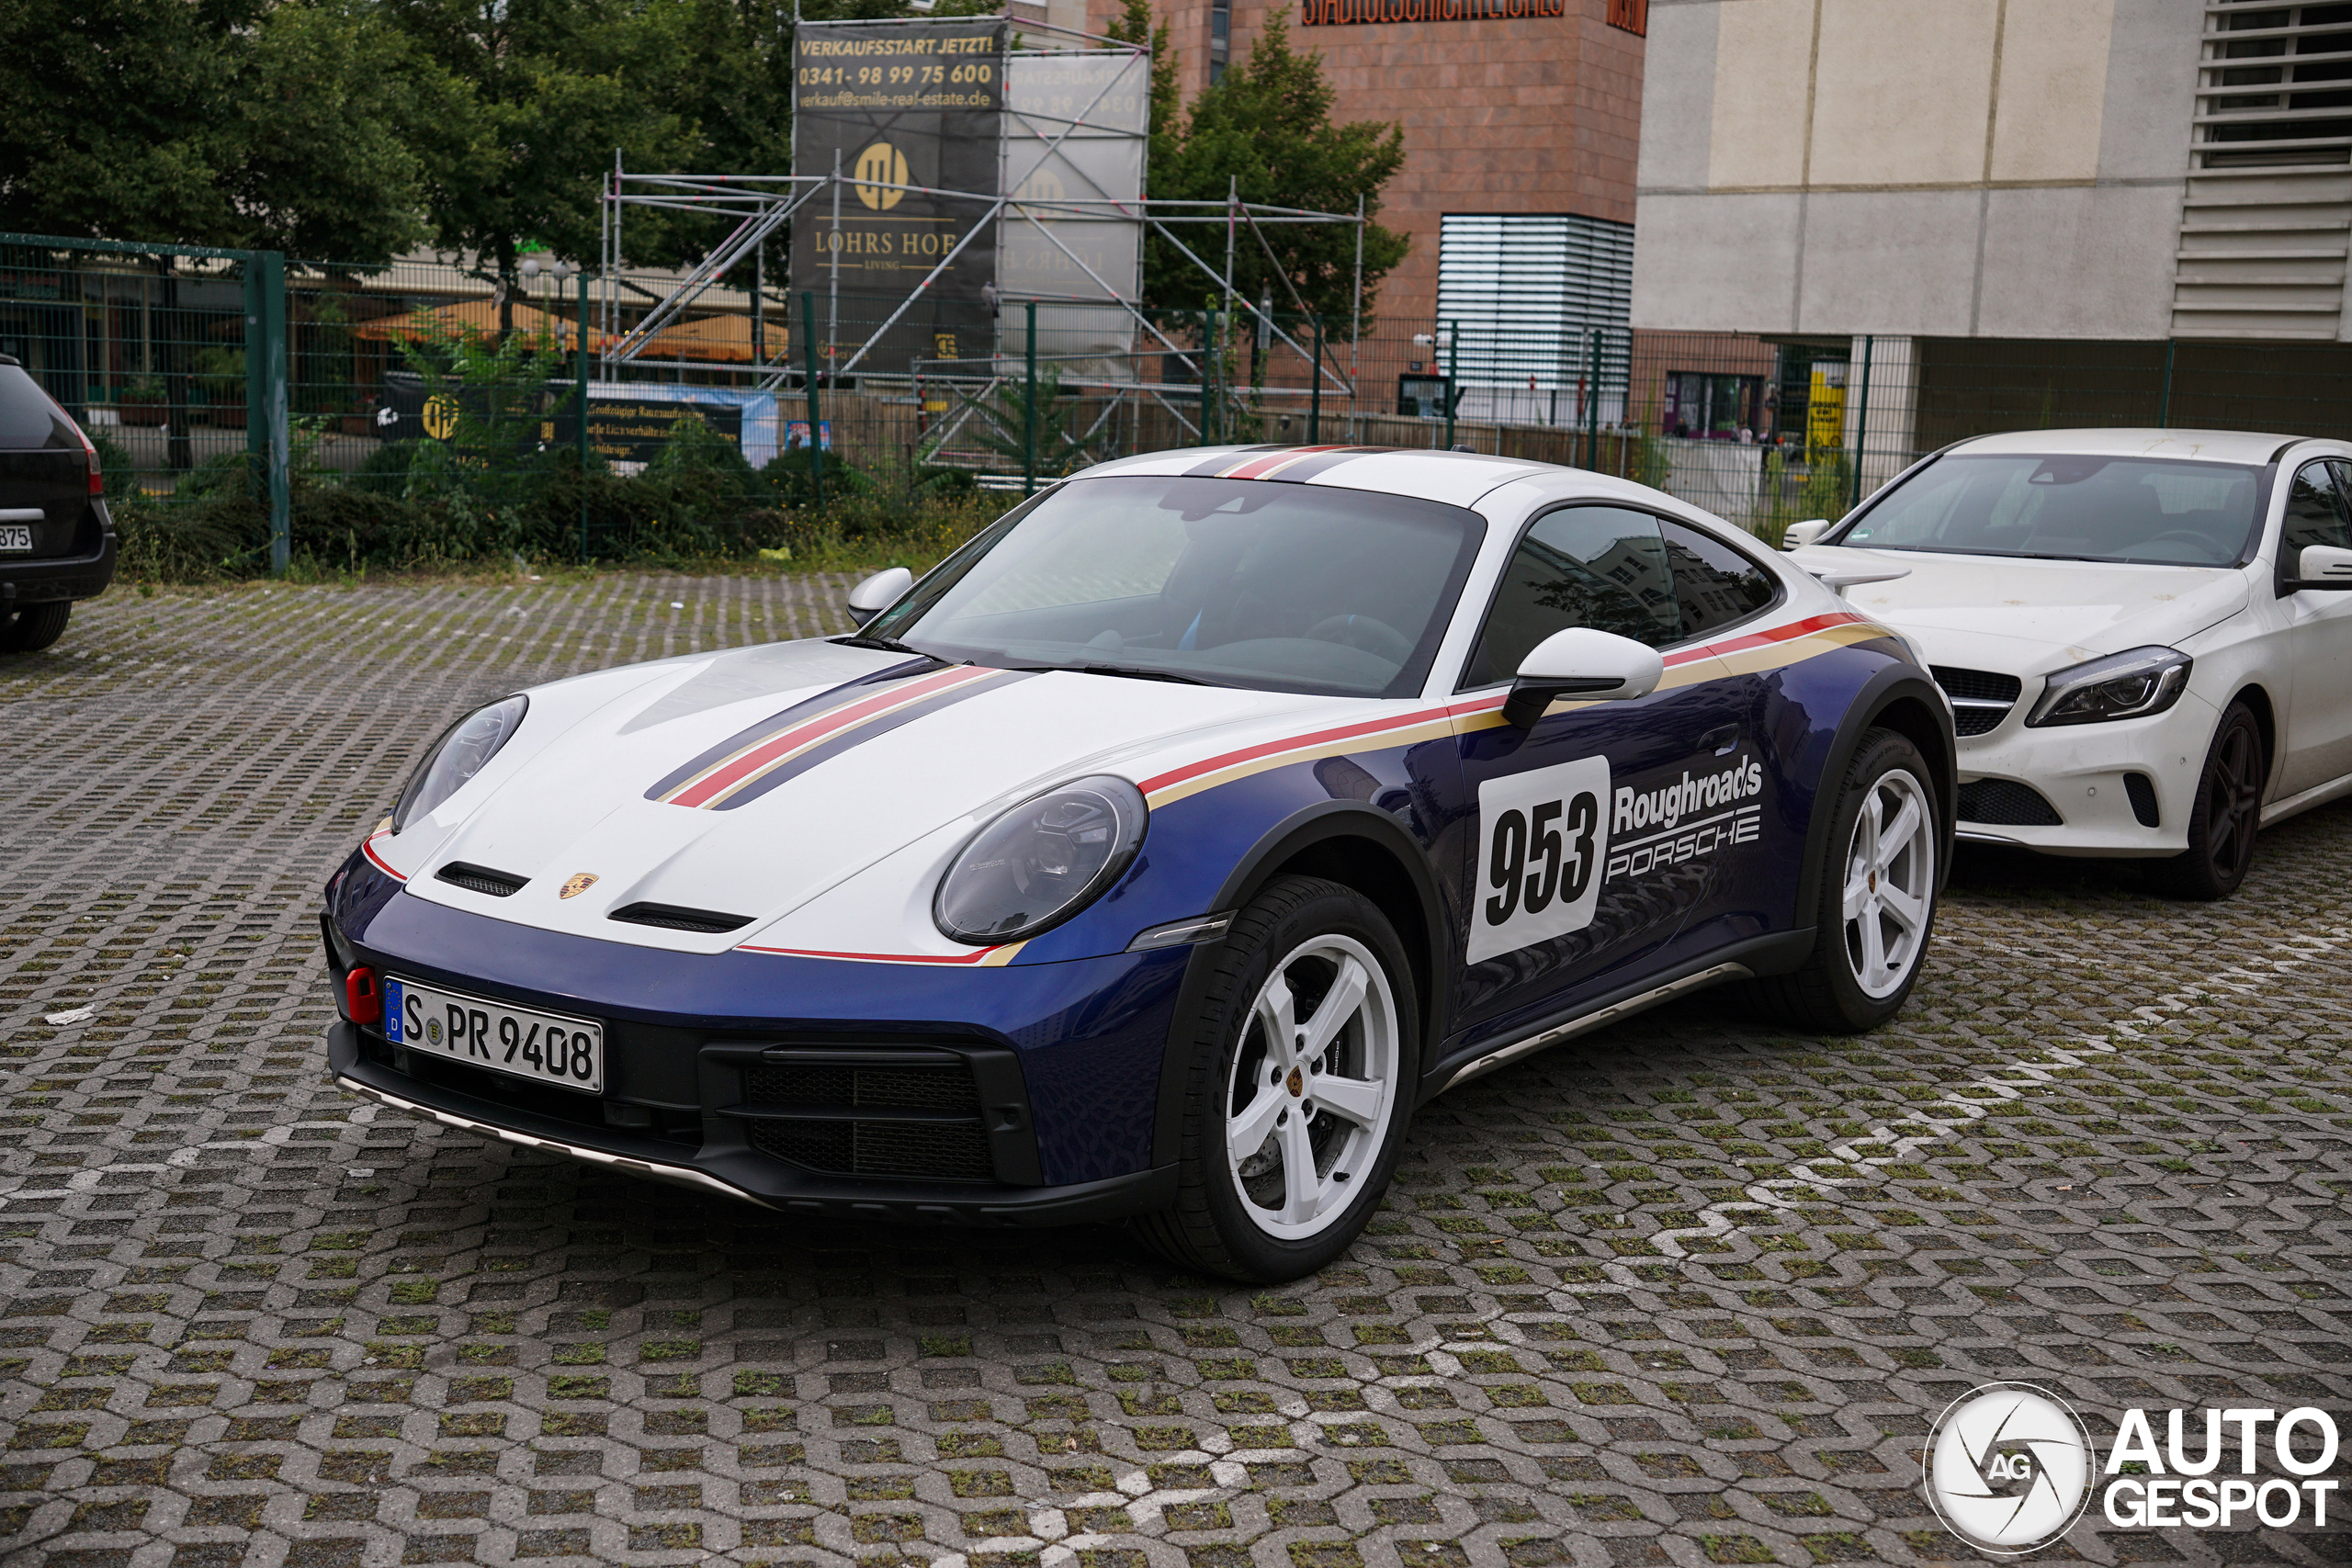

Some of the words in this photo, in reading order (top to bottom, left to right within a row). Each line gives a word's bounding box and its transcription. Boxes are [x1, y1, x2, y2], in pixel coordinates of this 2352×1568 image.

[799, 38, 937, 56] VERKAUFSSTART
[937, 36, 993, 53] JETZT!
[798, 66, 853, 85] 0341-
[858, 66, 882, 85] 98
[888, 65, 914, 85] 99
[921, 65, 944, 84] 75
[950, 63, 992, 84] 600
[798, 90, 991, 107] verkauf@smile-real-estate.de
[901, 232, 957, 255] HOF
[865, 260, 900, 270] LIVING
[1612, 754, 1762, 835] Roughroads
[1485, 790, 1599, 927] 953
[1605, 815, 1760, 886] PORSCHE
[390, 1017, 399, 1032] D
[404, 993, 423, 1041] S
[446, 1002, 491, 1060] PR
[499, 1016, 593, 1080] 9408
